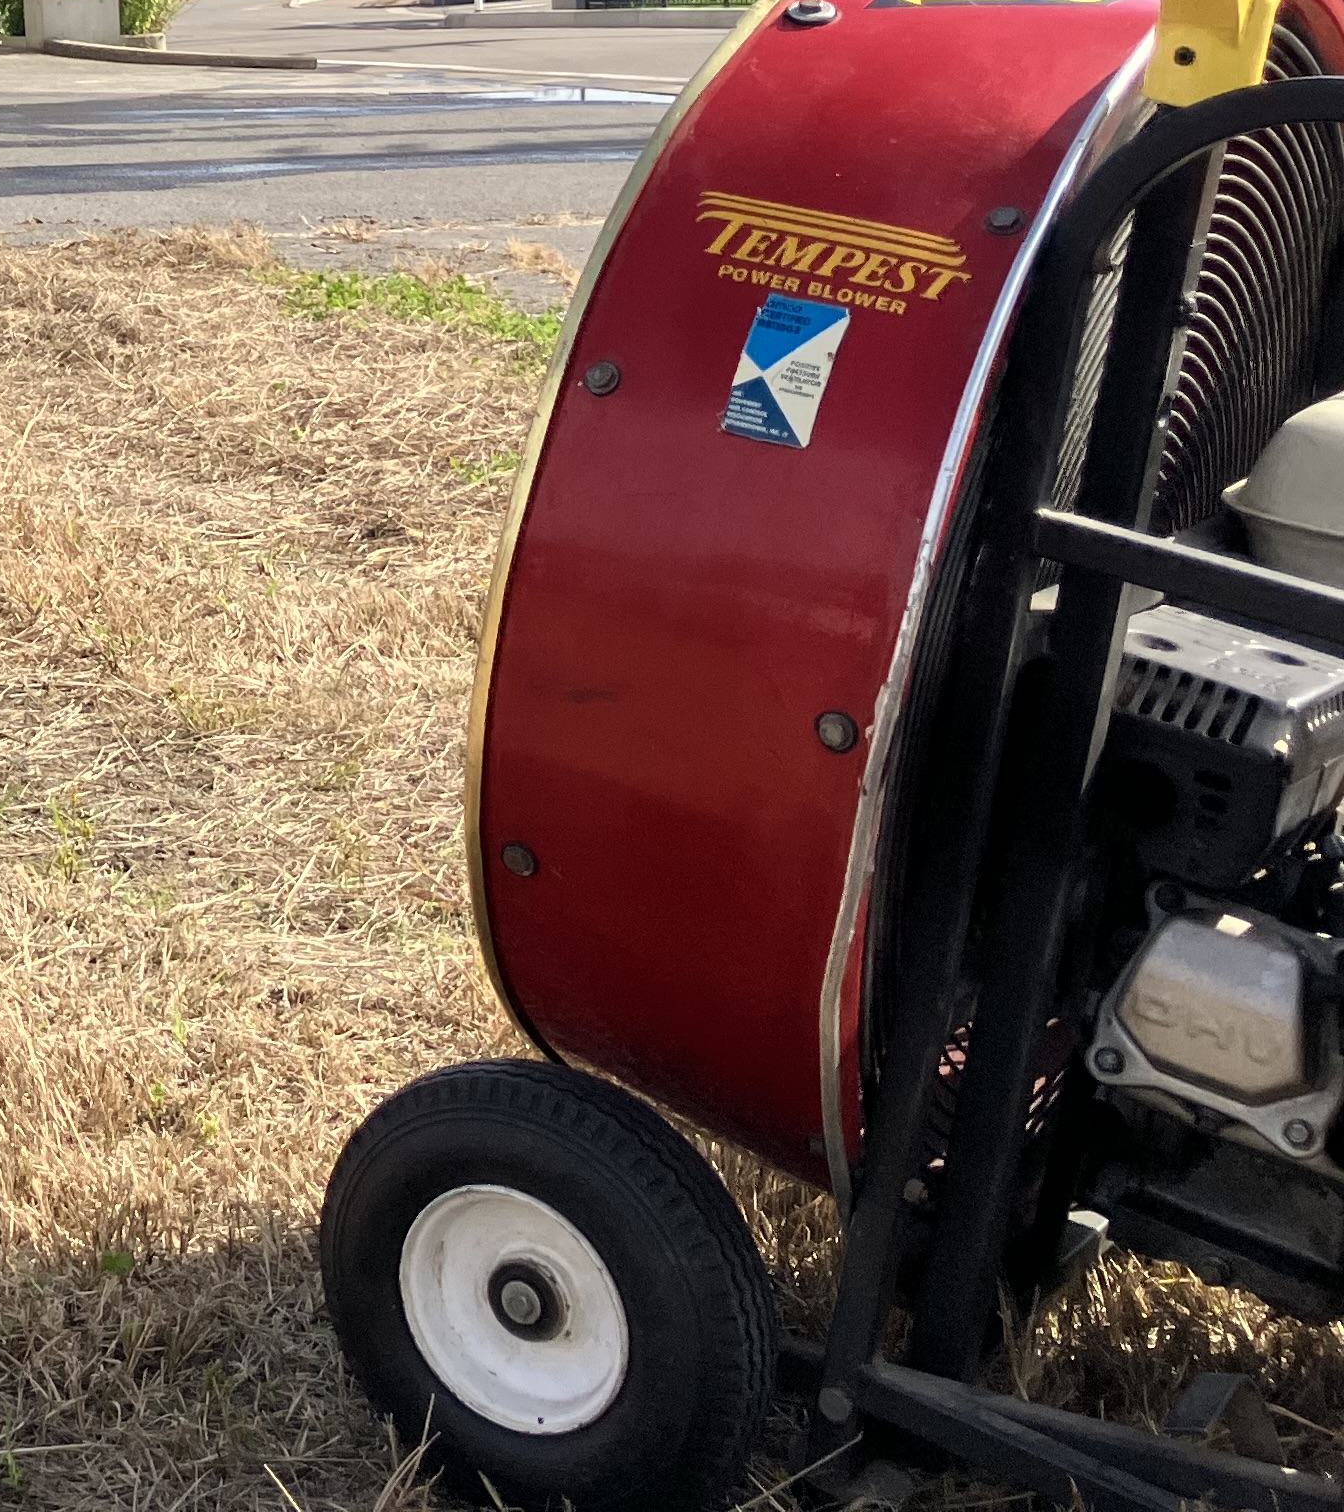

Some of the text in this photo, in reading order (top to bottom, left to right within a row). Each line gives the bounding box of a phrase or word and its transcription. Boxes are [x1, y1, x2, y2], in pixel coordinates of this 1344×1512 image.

[696, 210, 973, 302] TEMPEST
[717, 264, 909, 316] POWER BLOWER
